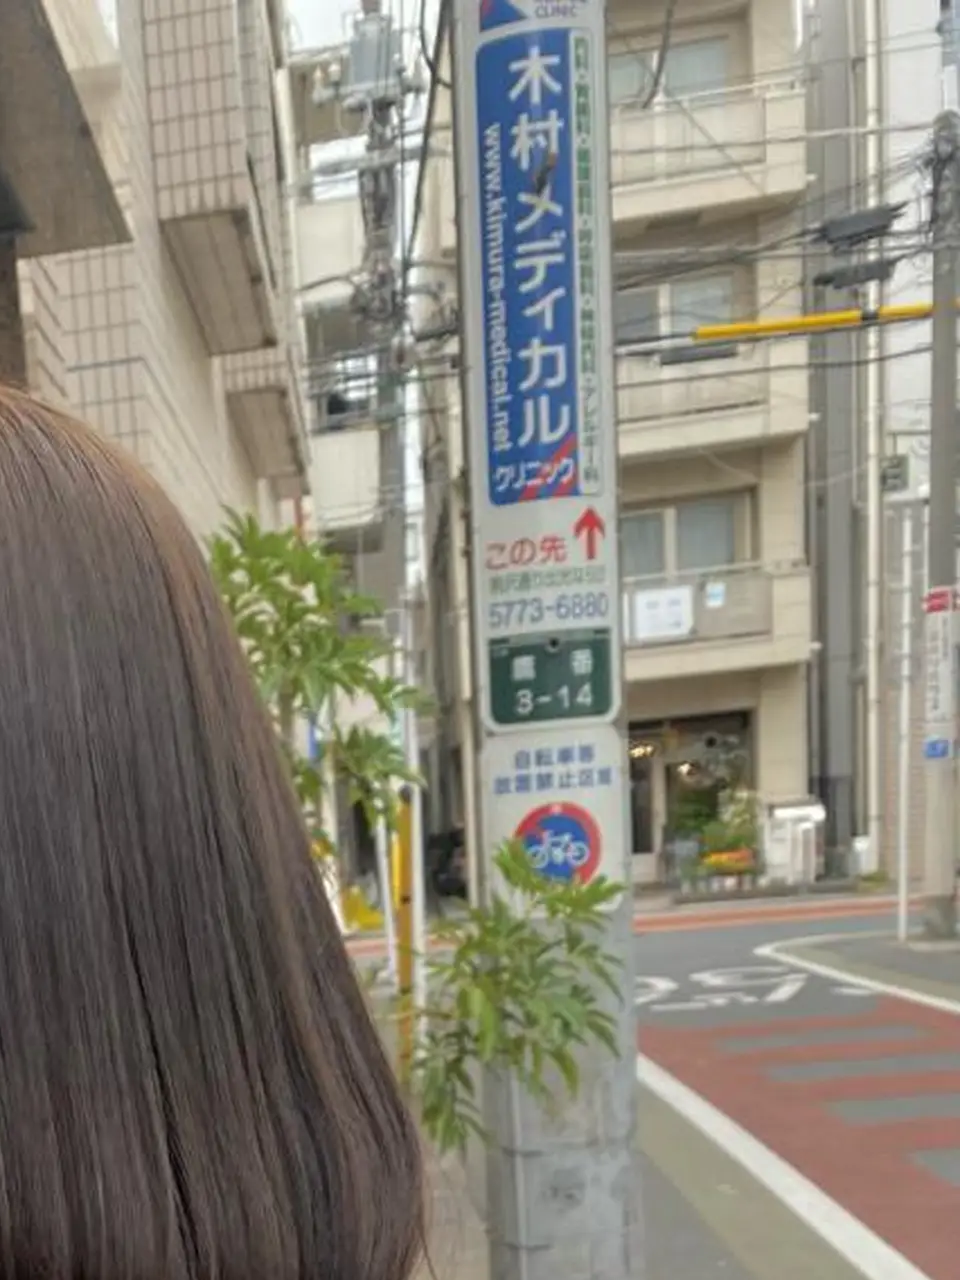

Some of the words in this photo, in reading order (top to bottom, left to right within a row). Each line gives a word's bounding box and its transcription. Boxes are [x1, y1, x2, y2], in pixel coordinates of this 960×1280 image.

[508, 45, 571, 448] 木村メディカル
[495, 456, 575, 492] クリニック
[485, 535, 567, 570] この先
[489, 592, 609, 628] 5773-6880
[515, 683, 593, 715] 3-14
